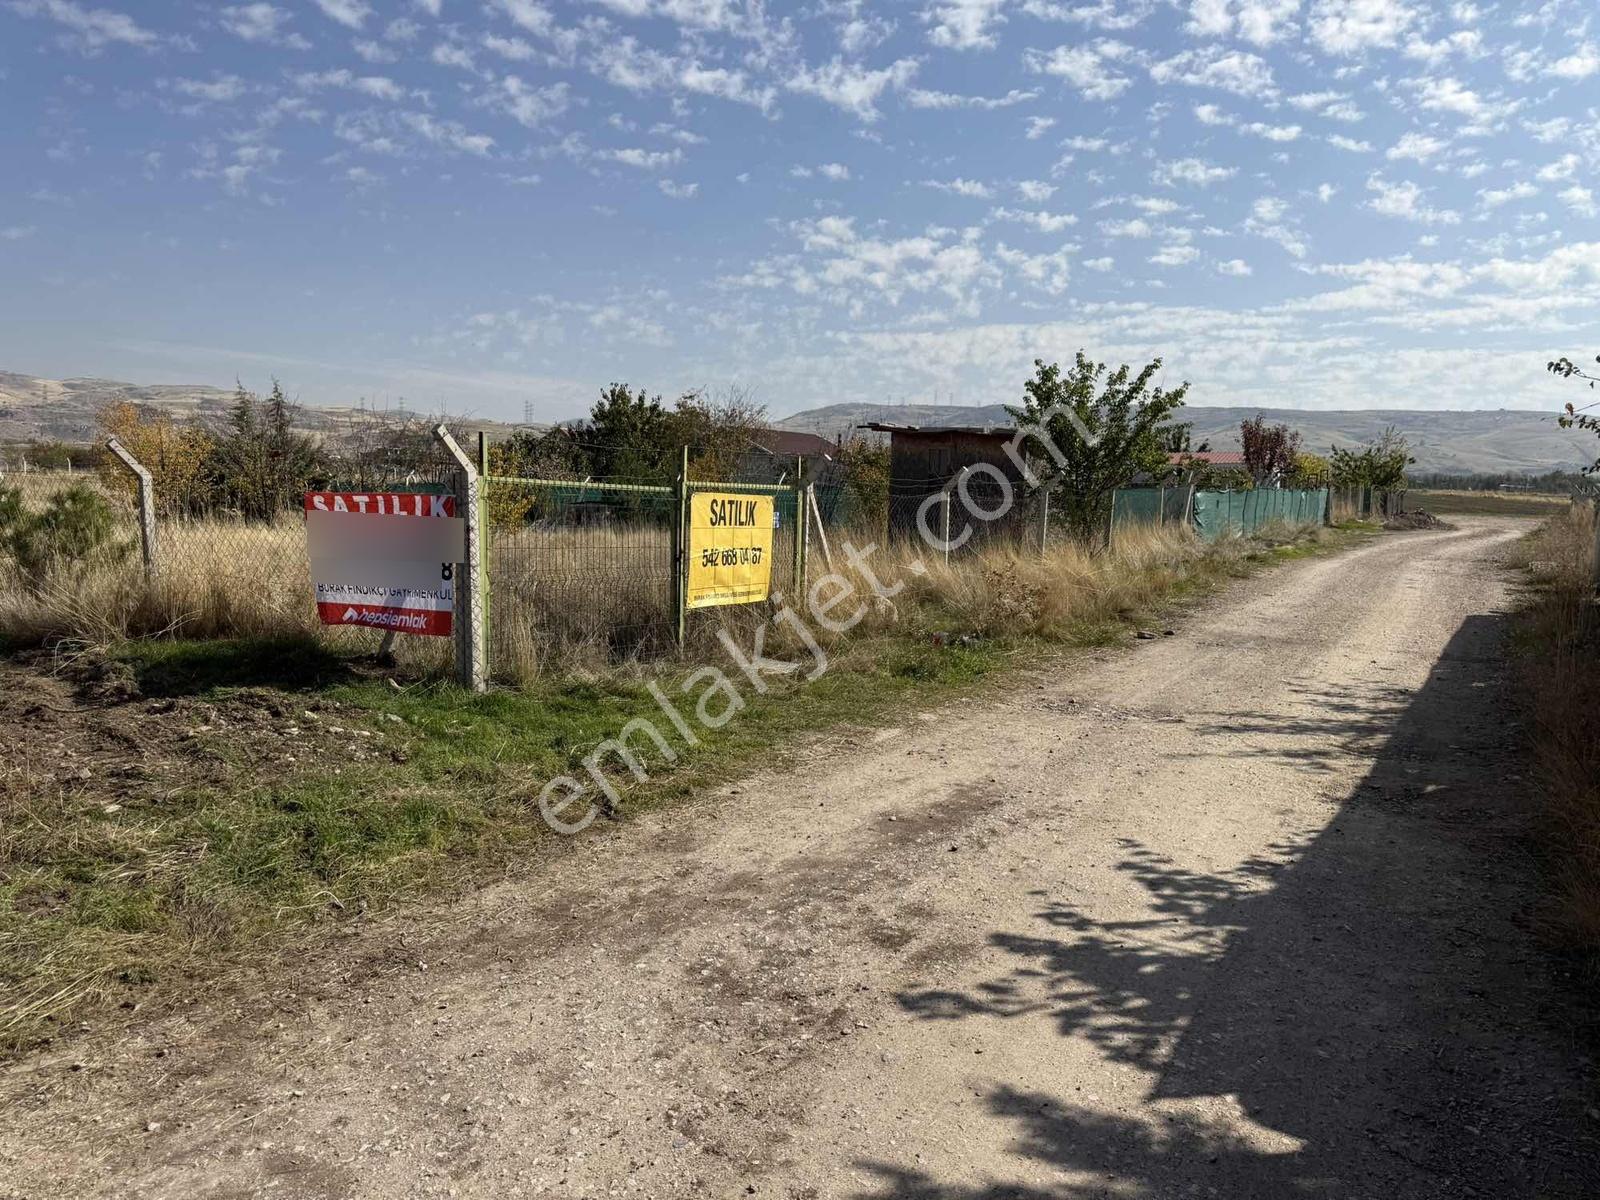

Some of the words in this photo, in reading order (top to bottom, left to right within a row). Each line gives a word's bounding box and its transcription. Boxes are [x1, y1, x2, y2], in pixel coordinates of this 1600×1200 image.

[312, 495, 448, 517] SATILIK
[710, 498, 757, 526] SATILIK
[702, 548, 719, 568] 542
[358, 608, 427, 629] hepsiemlak
